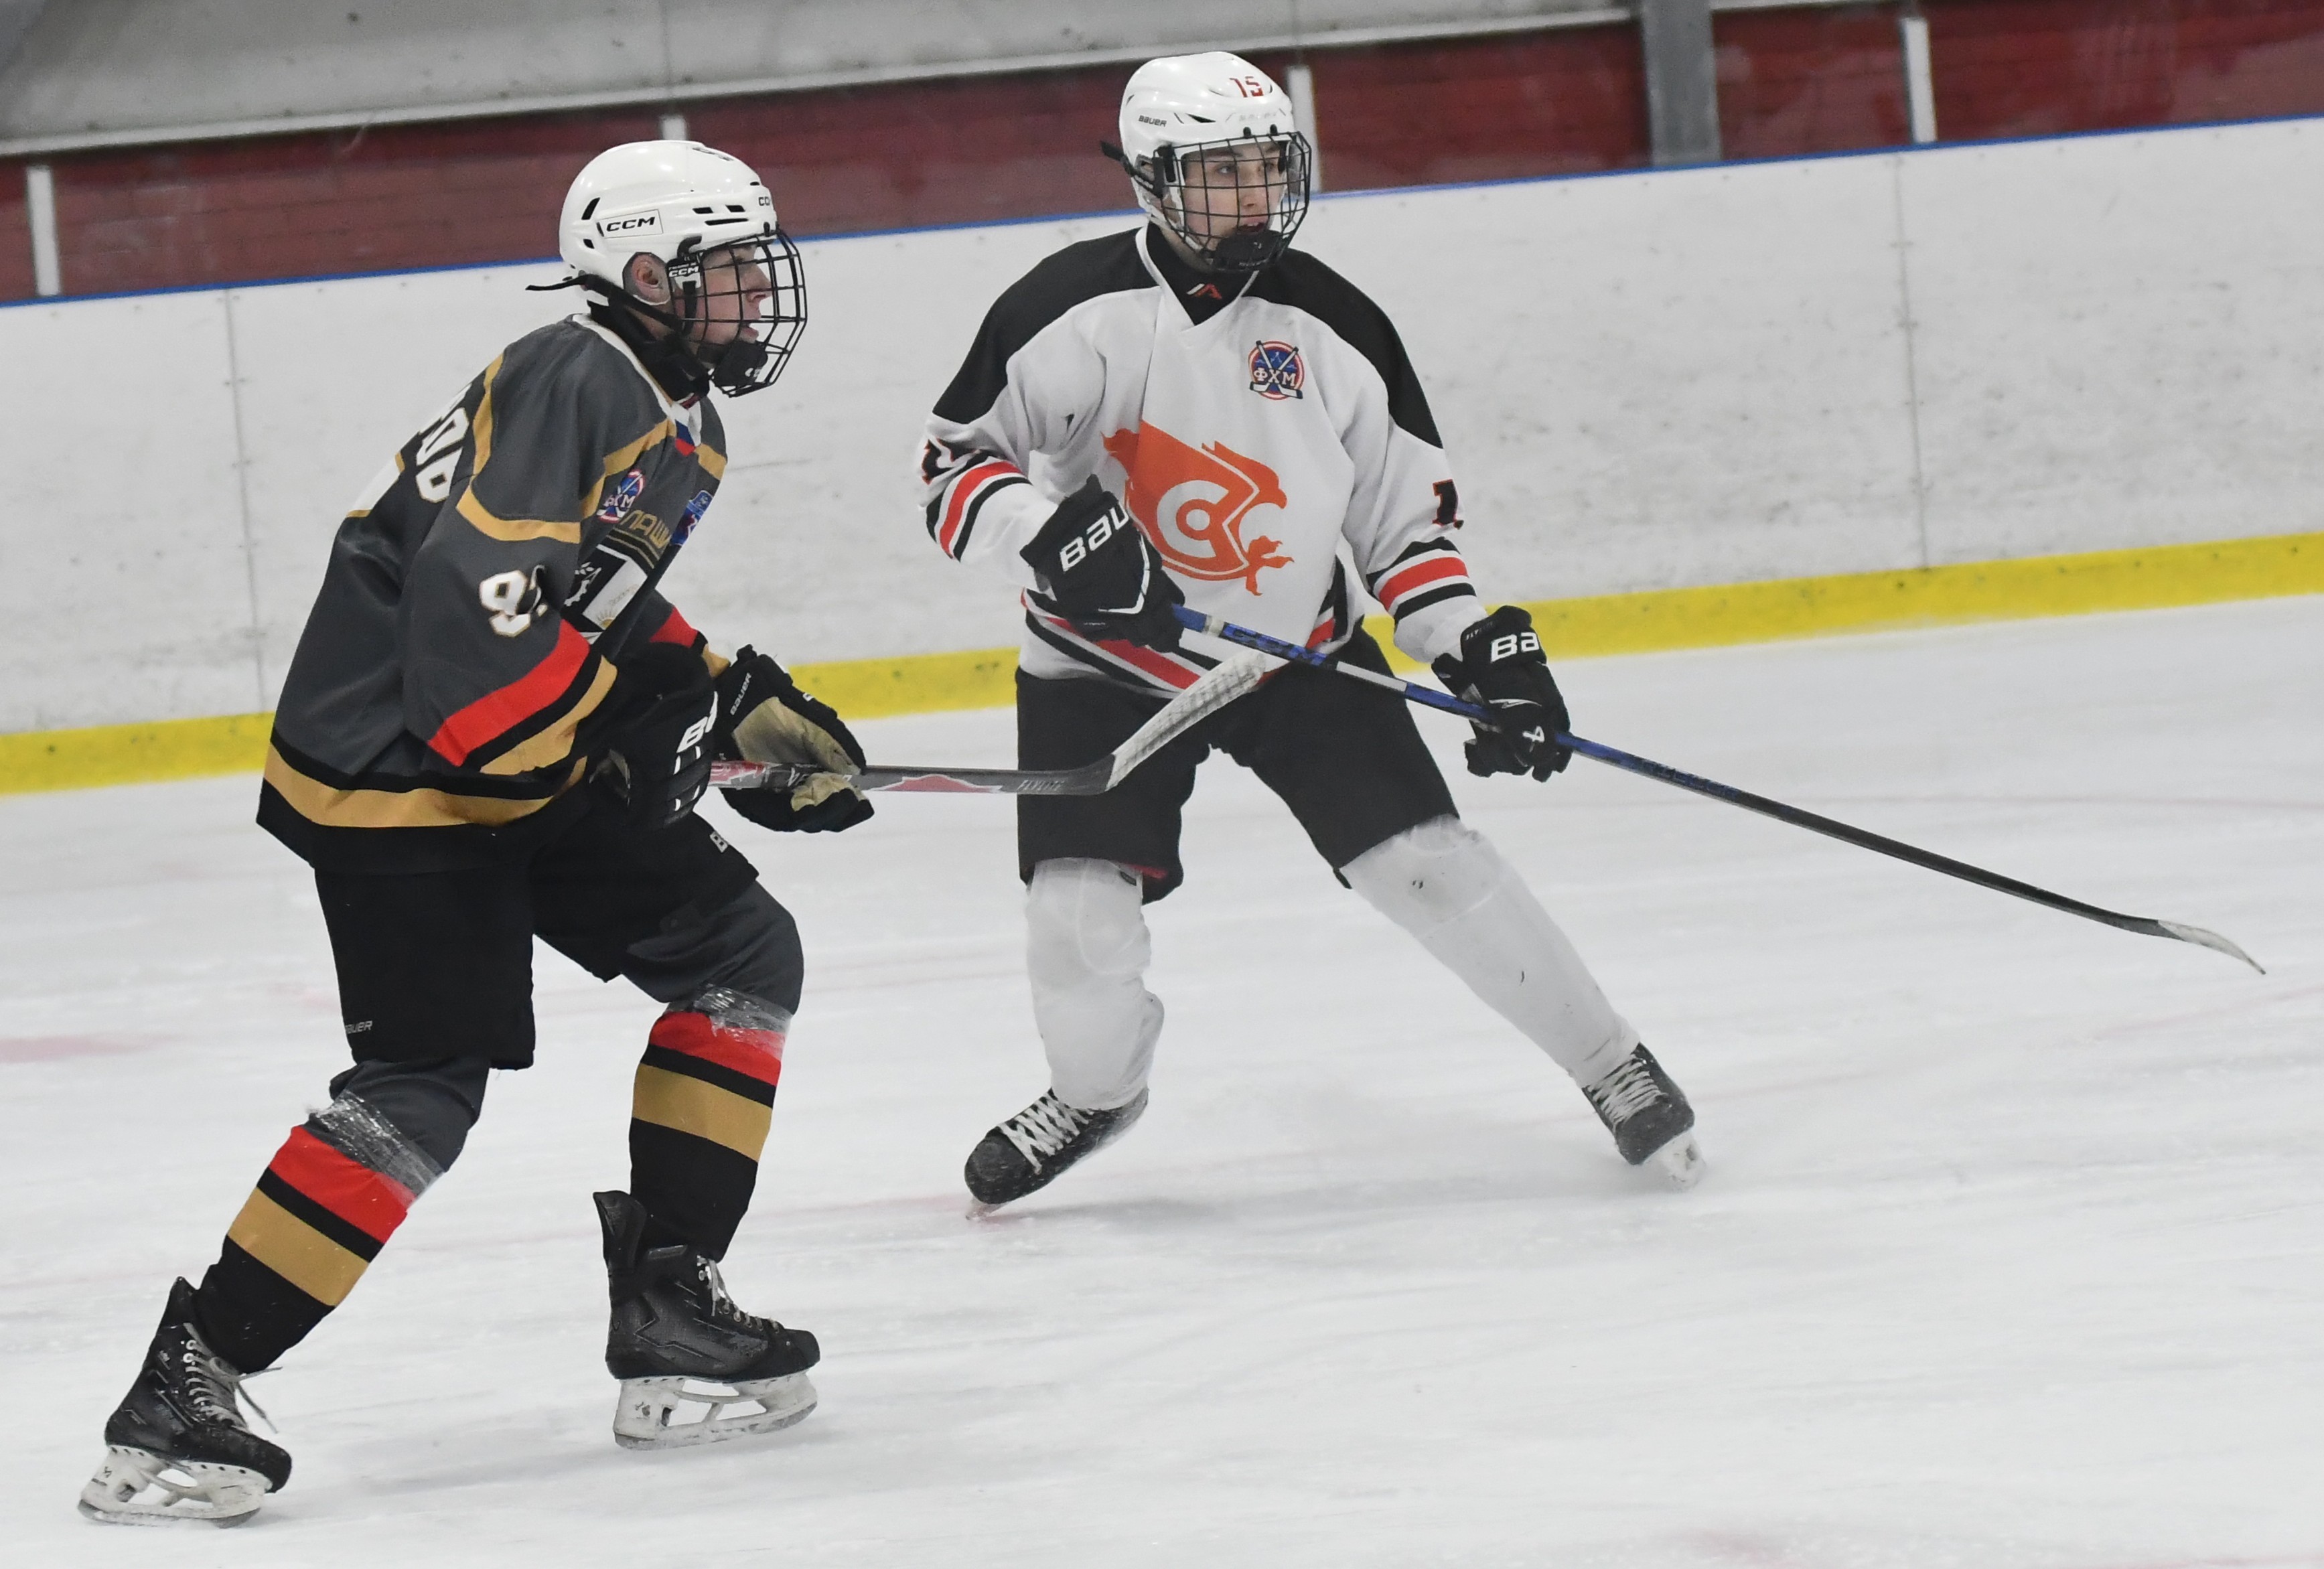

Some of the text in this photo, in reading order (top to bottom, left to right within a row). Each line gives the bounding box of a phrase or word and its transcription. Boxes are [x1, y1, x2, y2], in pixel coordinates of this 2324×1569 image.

[1229, 76, 1264, 98] 15
[1139, 115, 1167, 127] BAUER
[606, 216, 655, 232] CCM
[668, 266, 699, 277] CCM
